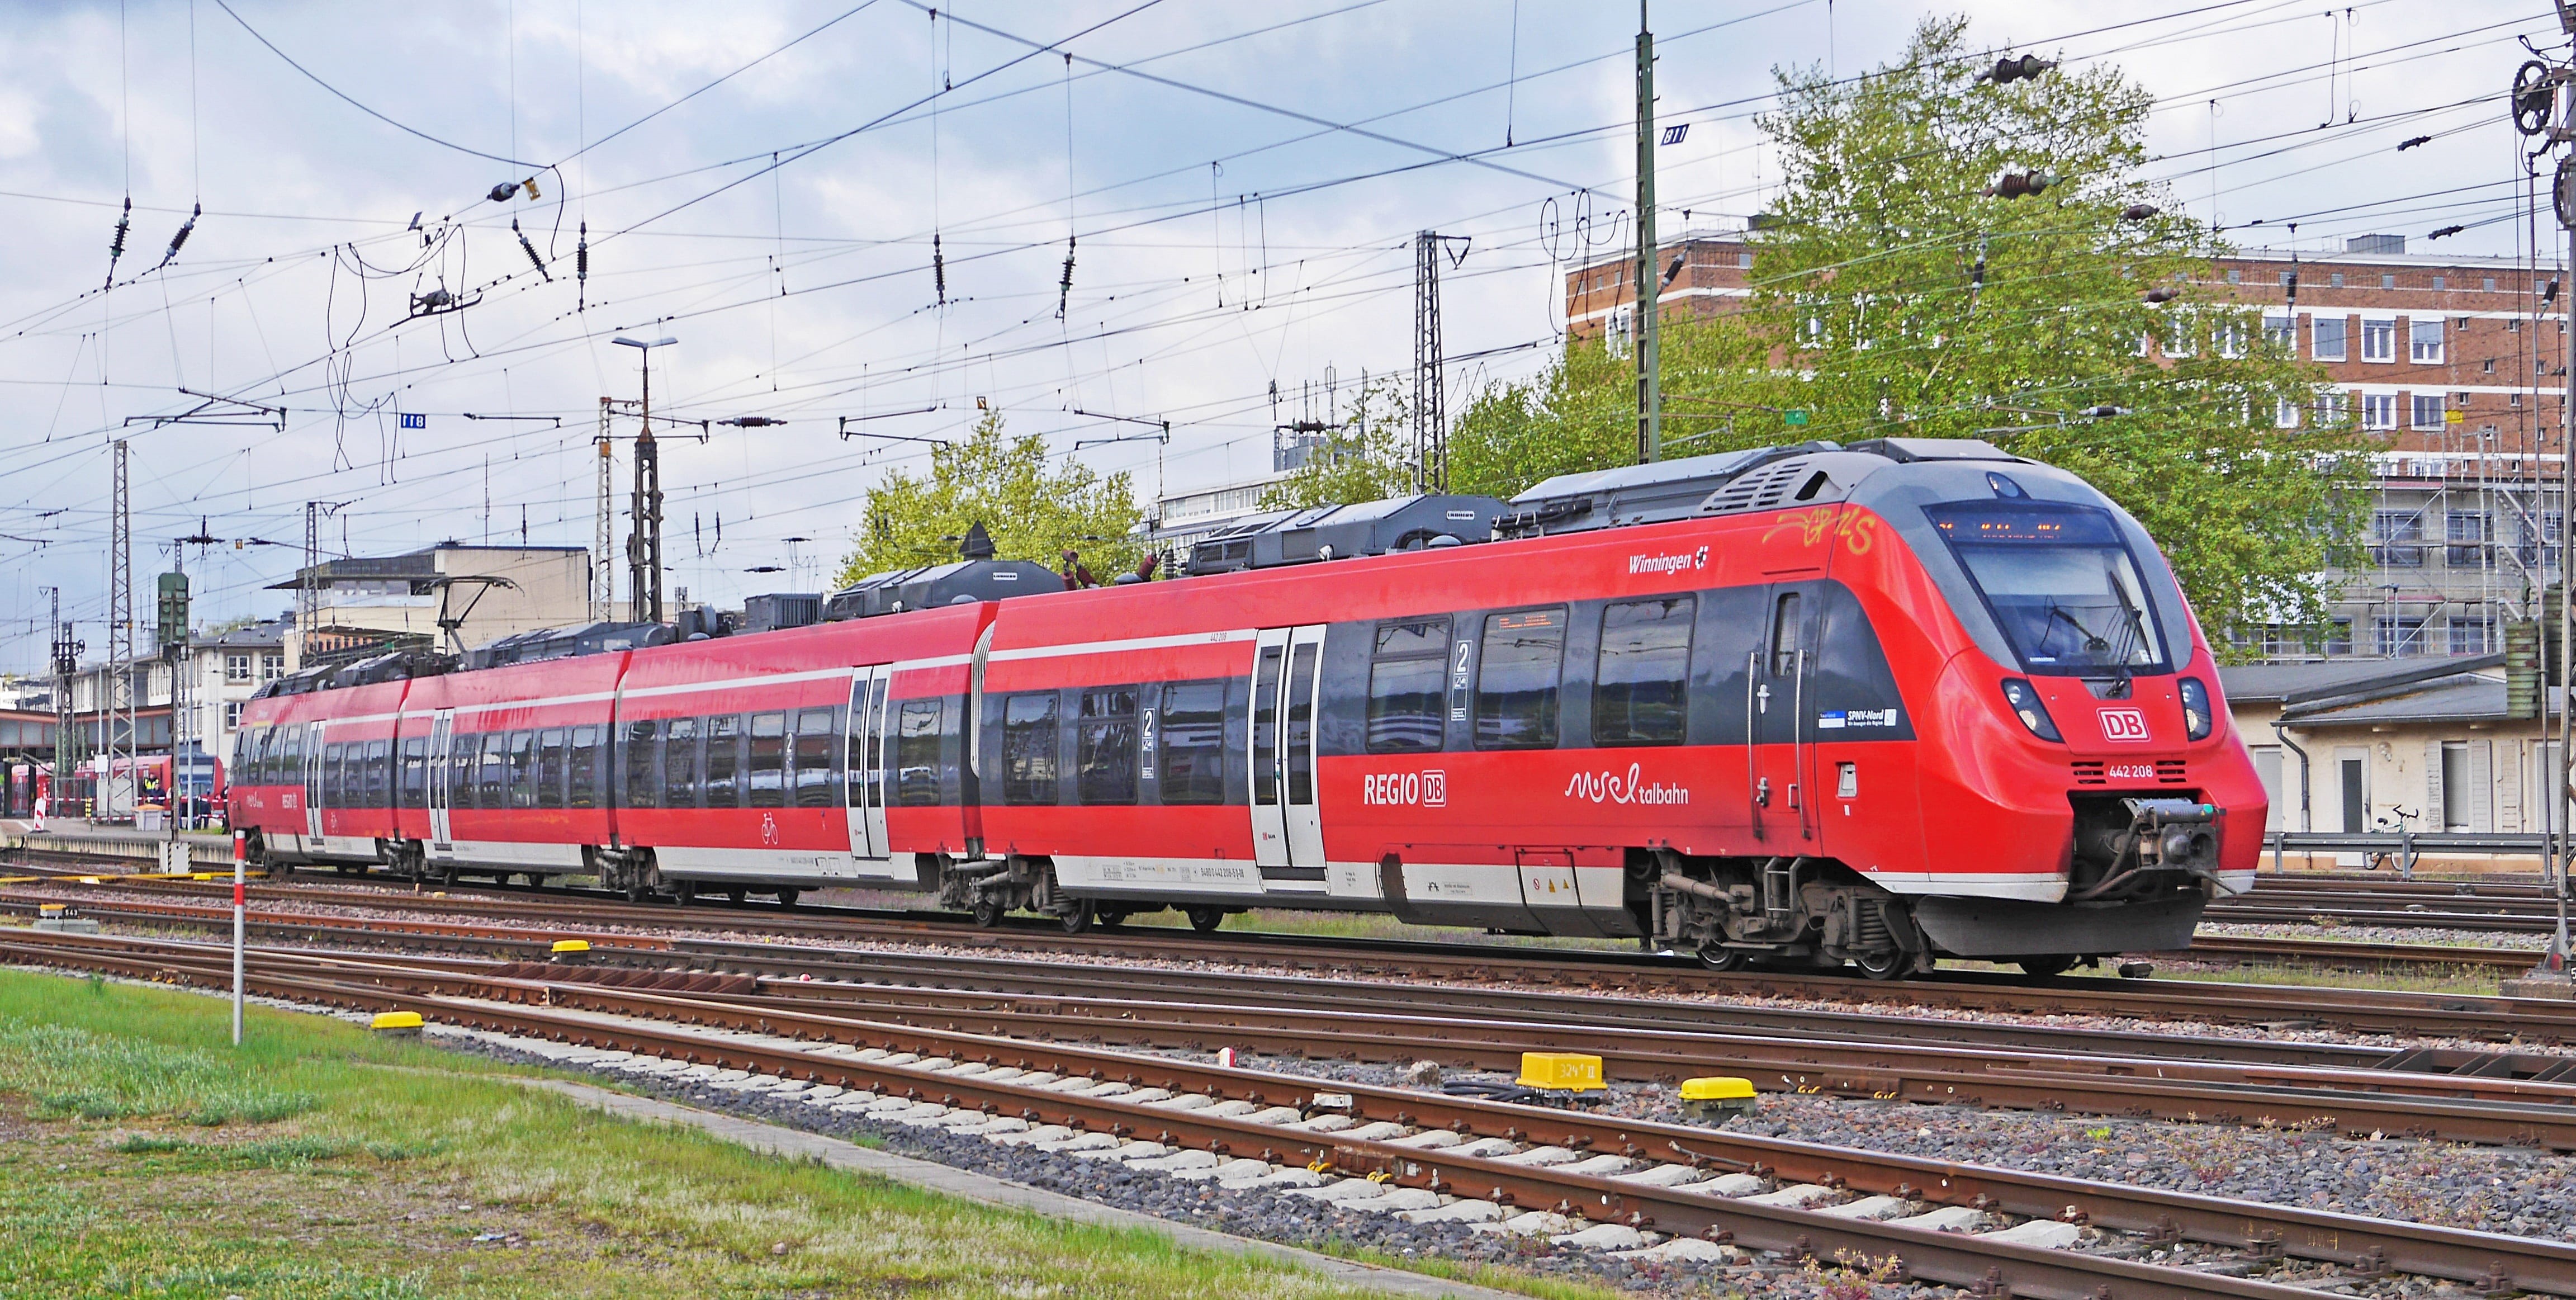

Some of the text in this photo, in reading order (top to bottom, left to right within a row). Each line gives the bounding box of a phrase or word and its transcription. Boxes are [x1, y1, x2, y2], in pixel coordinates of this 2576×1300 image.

[1663, 126, 1686, 144] 811
[1629, 551, 1692, 575] Winningen
[1456, 643, 1468, 672] 2
[1144, 711, 1153, 737] 2
[1848, 709, 1884, 721] SPNV-Nord
[2102, 712, 2146, 738] DB
[787, 732, 792, 753] 2
[2109, 765, 2153, 778] 442 208
[1364, 773, 1444, 805] REGIO DB
